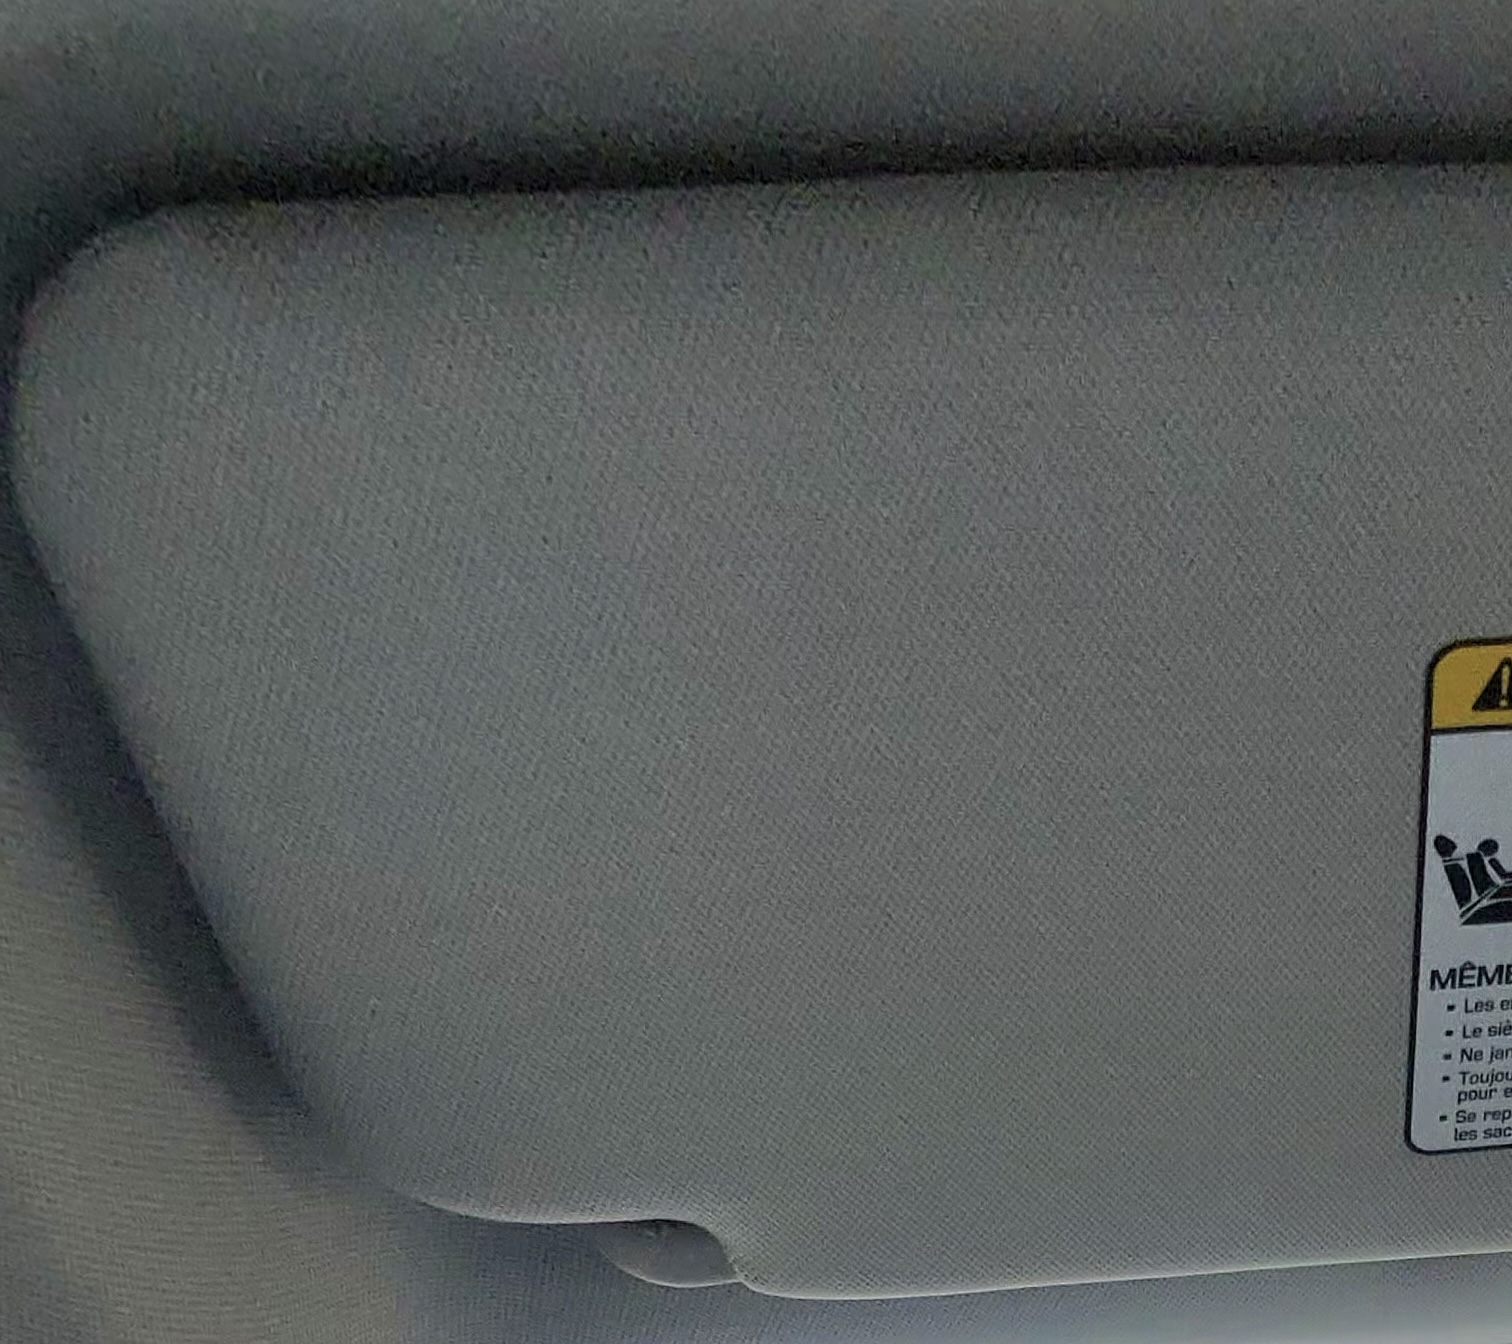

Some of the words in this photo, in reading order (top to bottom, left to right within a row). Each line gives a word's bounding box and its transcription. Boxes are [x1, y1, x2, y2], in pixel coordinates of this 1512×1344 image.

[1463, 997, 1495, 1014] Les
[1461, 1023, 1482, 1039] Le
[1459, 1047, 1483, 1063] Ne
[1456, 1085, 1497, 1105] pour
[1455, 1109, 1476, 1123] Se
[1453, 1127, 1477, 1142] les
